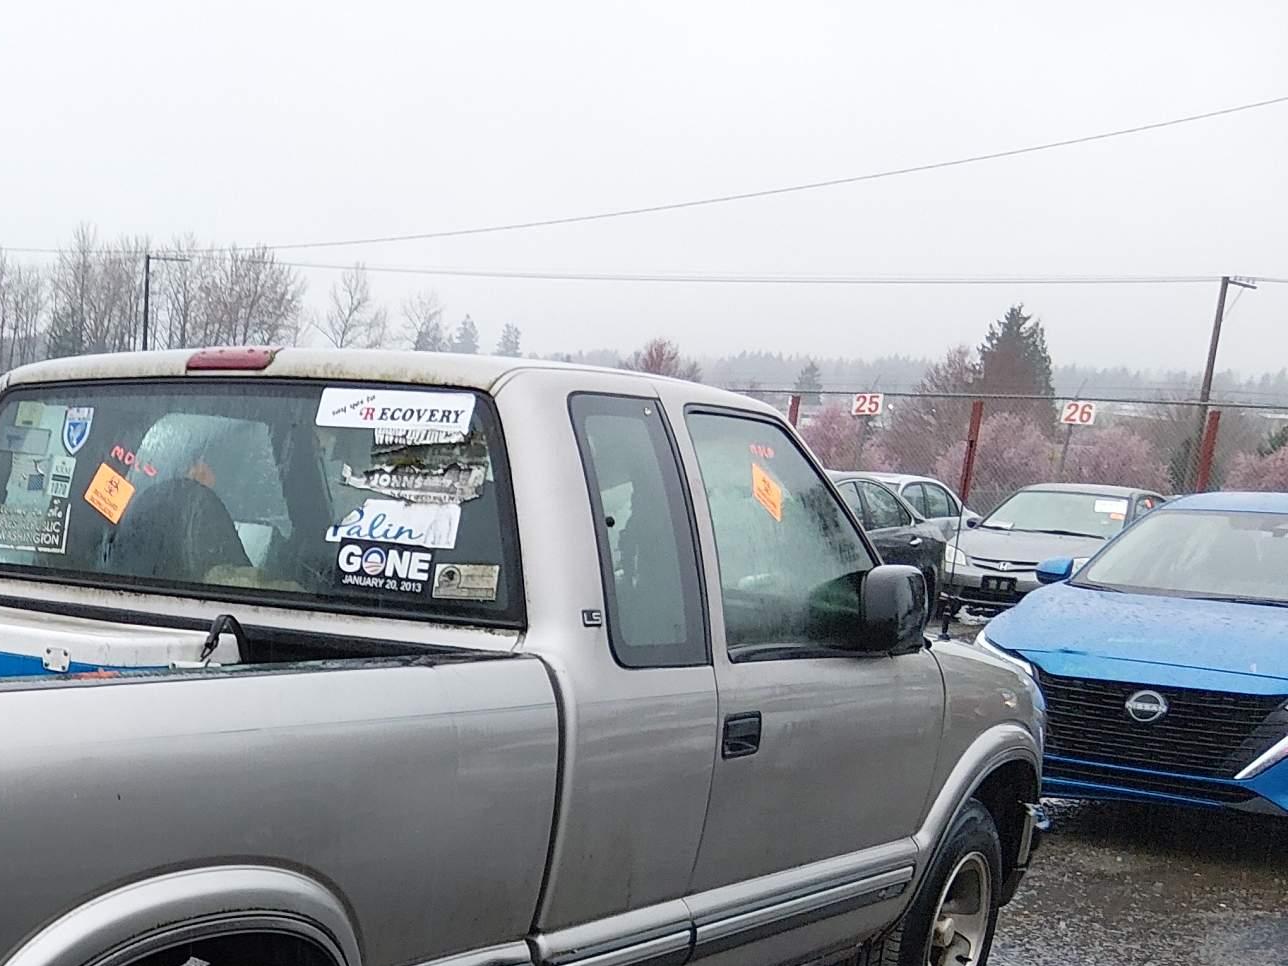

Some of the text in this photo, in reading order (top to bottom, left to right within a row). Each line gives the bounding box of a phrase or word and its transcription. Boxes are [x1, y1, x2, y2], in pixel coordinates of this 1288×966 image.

[855, 395, 880, 413] 25
[1064, 403, 1093, 422] 26
[361, 406, 466, 424] RECOVERY
[332, 506, 424, 541] Palin
[338, 544, 432, 581] GONE
[342, 574, 422, 593] JANUARY 20, 2013
[583, 612, 602, 625] LS
